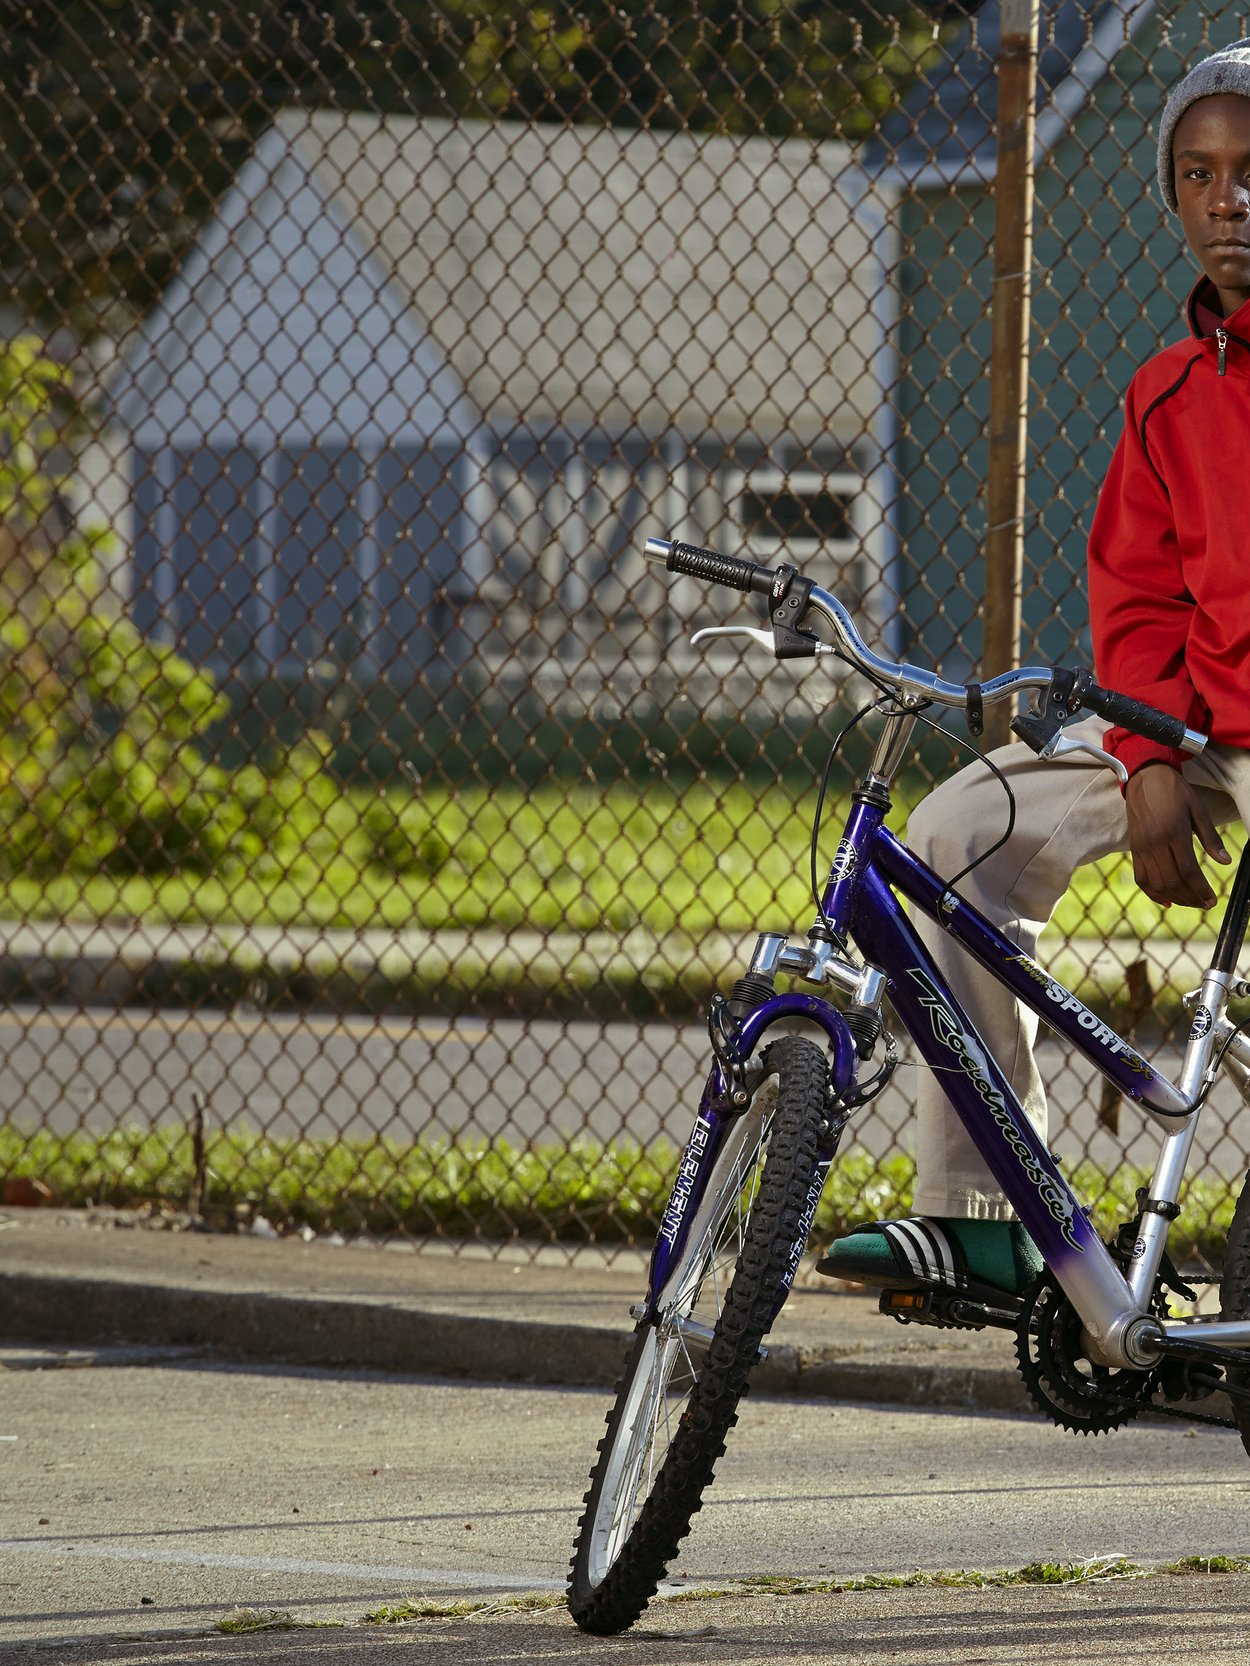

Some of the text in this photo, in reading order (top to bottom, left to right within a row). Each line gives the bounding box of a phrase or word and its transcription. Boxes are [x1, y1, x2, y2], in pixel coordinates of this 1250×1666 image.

[1045, 982, 1130, 1055] SPORT
[906, 967, 1085, 1253] Roadmaster
[661, 1127, 709, 1255] ELEMENT
